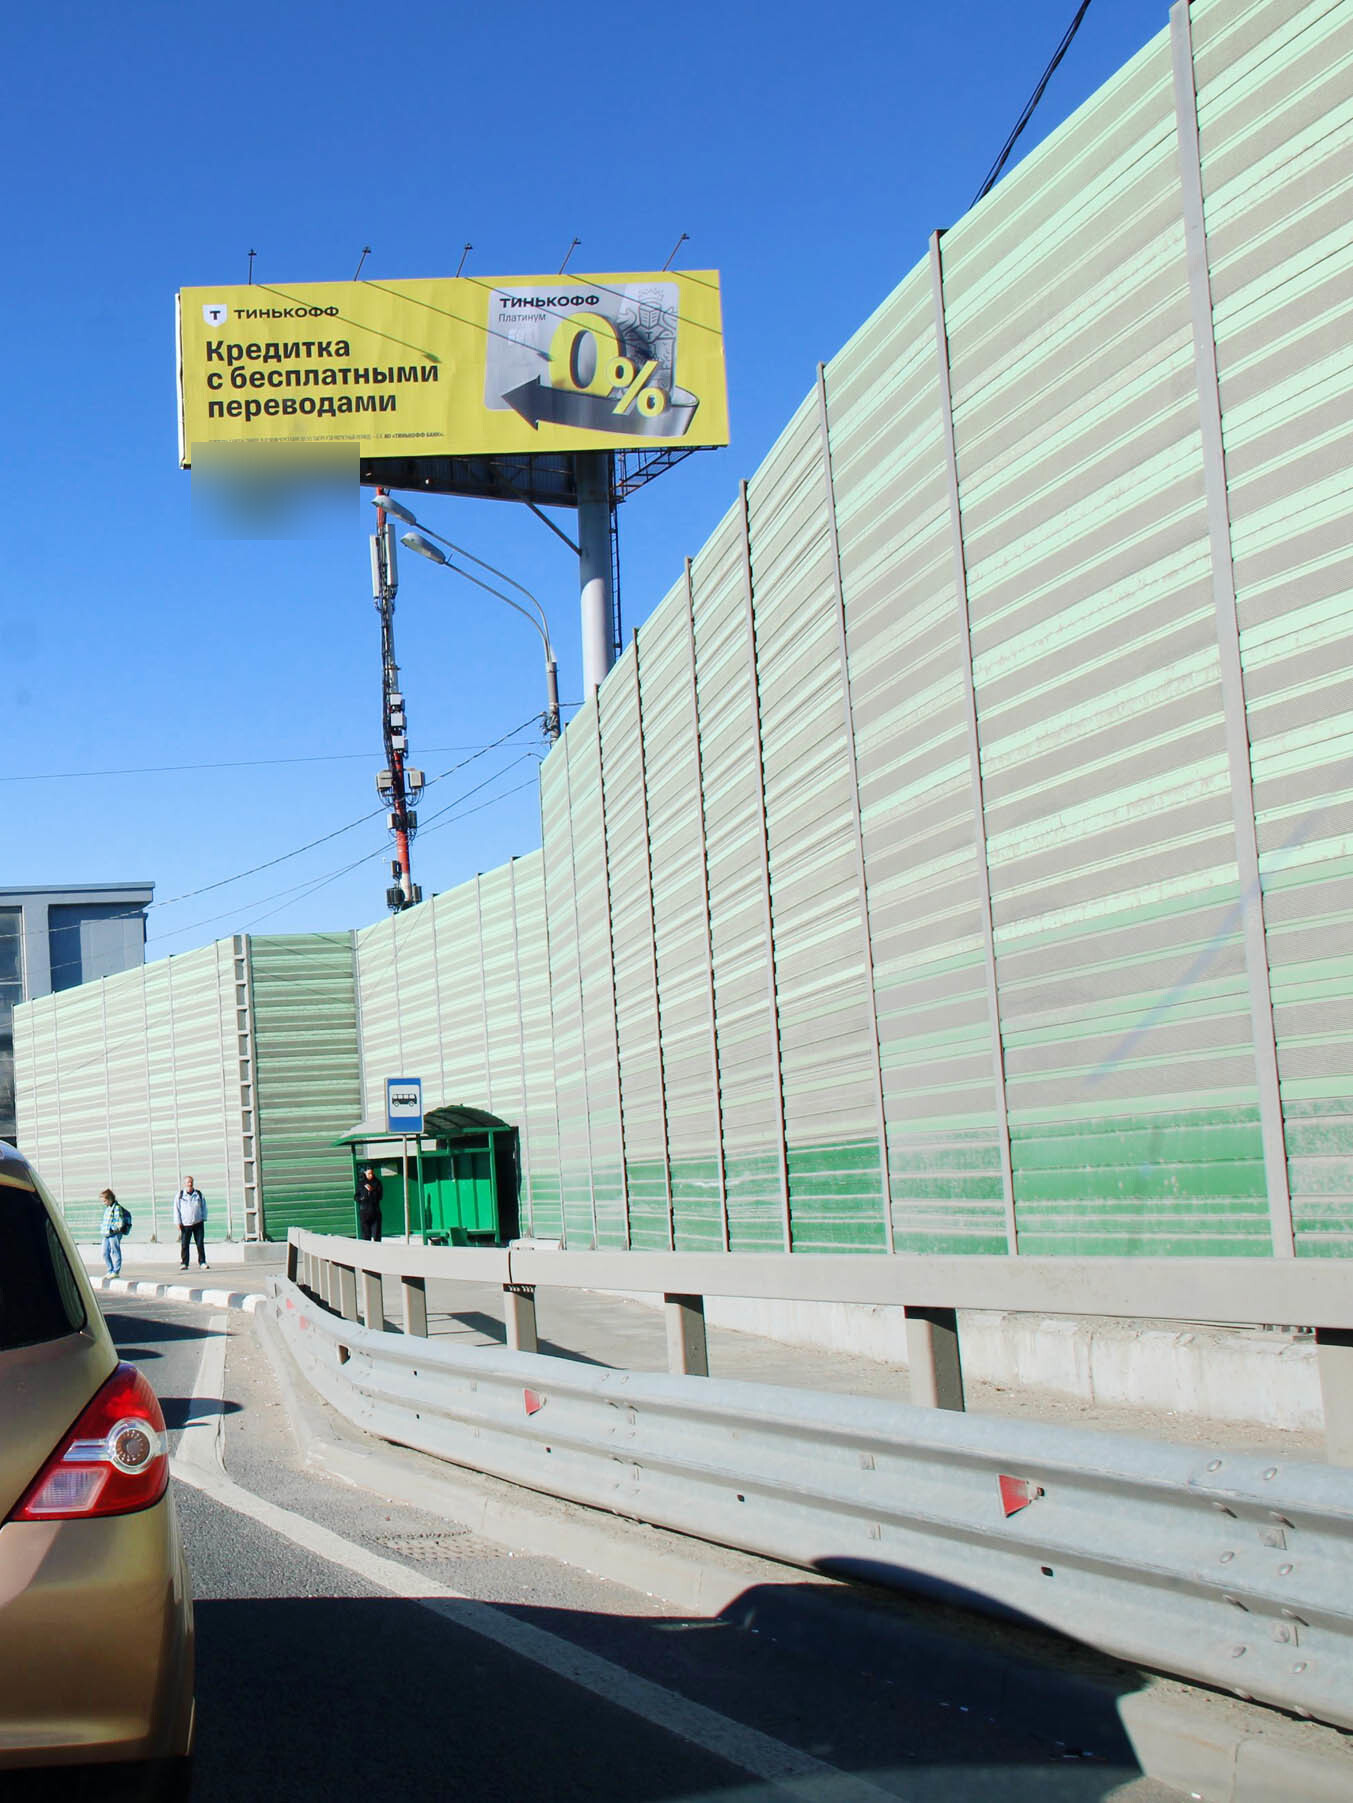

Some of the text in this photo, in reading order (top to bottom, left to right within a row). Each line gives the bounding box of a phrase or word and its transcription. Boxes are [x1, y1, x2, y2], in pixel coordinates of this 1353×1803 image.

[499, 295, 600, 308] ТИНЬКОФФ
[234, 306, 339, 319] ТИНЬКОФФ
[498, 312, 547, 323] Платинум
[206, 340, 350, 366] Кредитка
[207, 365, 439, 390] с бесплатными
[208, 394, 396, 421] переводами
